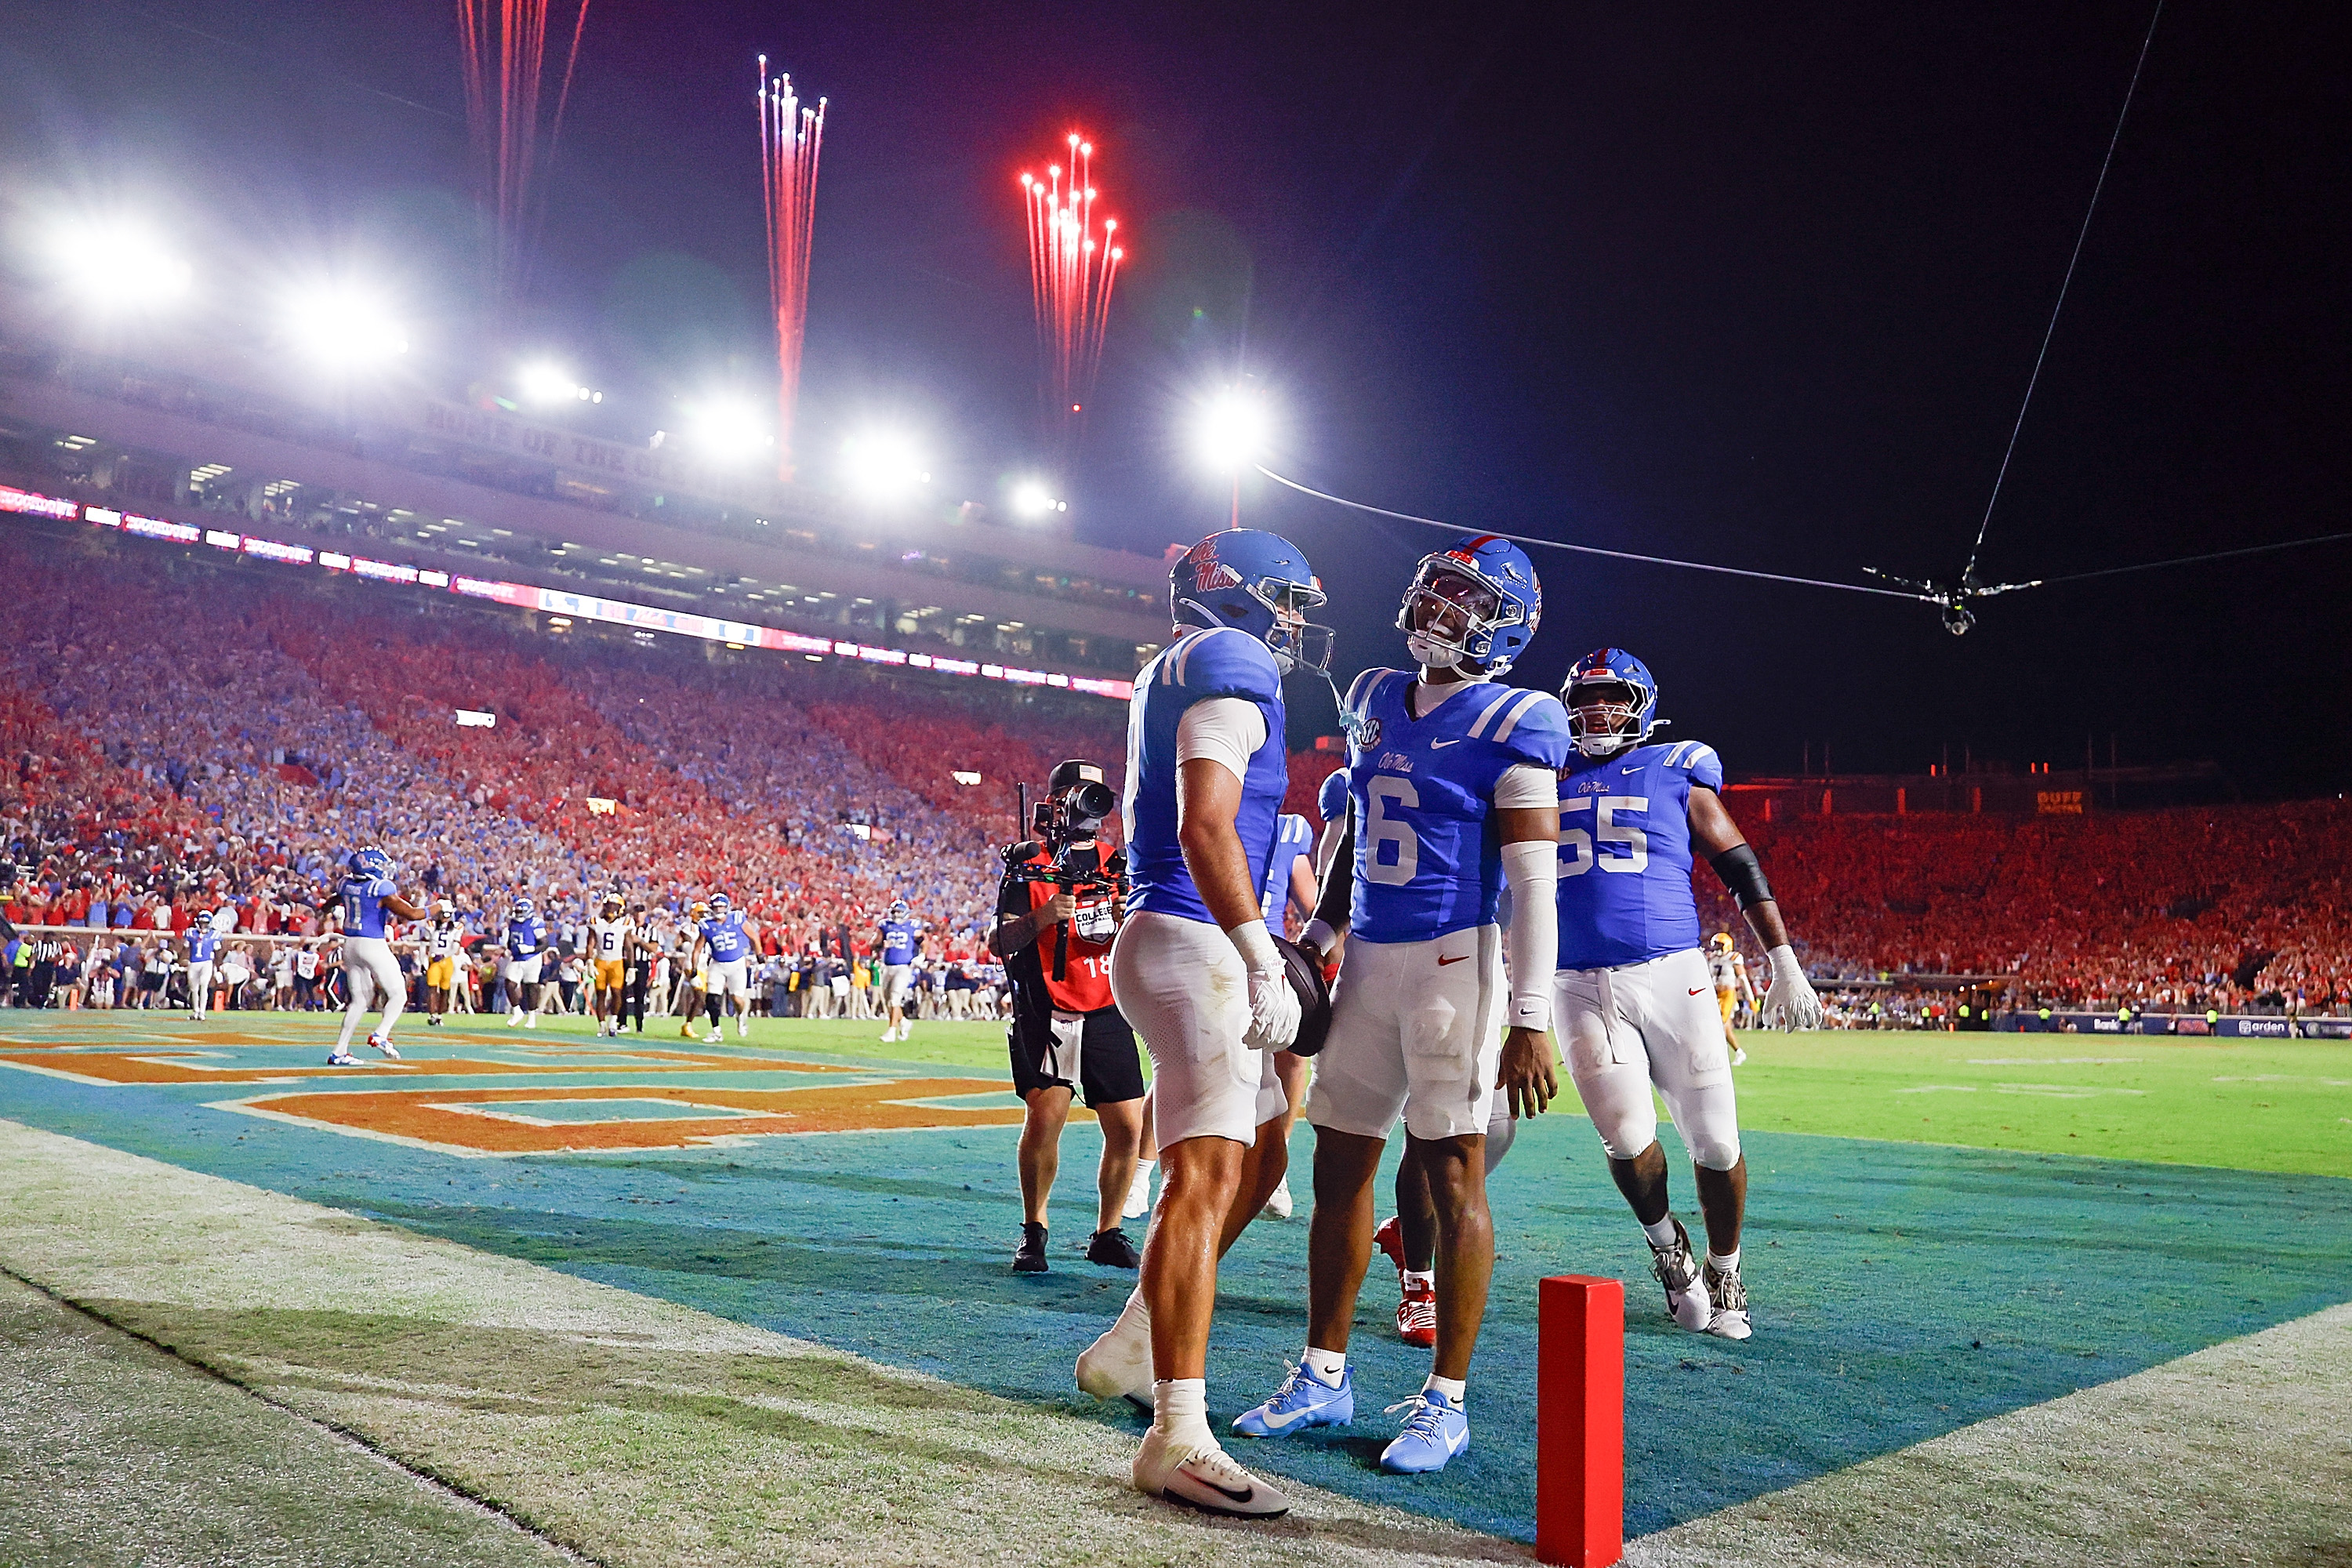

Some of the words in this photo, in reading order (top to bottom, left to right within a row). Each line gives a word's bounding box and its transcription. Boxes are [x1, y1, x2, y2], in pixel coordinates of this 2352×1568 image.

[1189, 539, 1217, 564] Ole
[1196, 561, 1238, 593] Miss
[1377, 752, 1393, 769] Ole
[1392, 753, 1414, 773] Miss
[1577, 782, 1591, 793] Ole
[1367, 775, 1420, 886] 6
[1557, 796, 1649, 879] 55
[1076, 906, 1112, 922] COLLEGE
[195, 942, 203, 958] 1
[437, 932, 448, 948] 5
[603, 932, 614, 950] 6
[712, 931, 739, 952] 65
[1083, 955, 1109, 978] 18
[1714, 965, 1722, 982] 7
